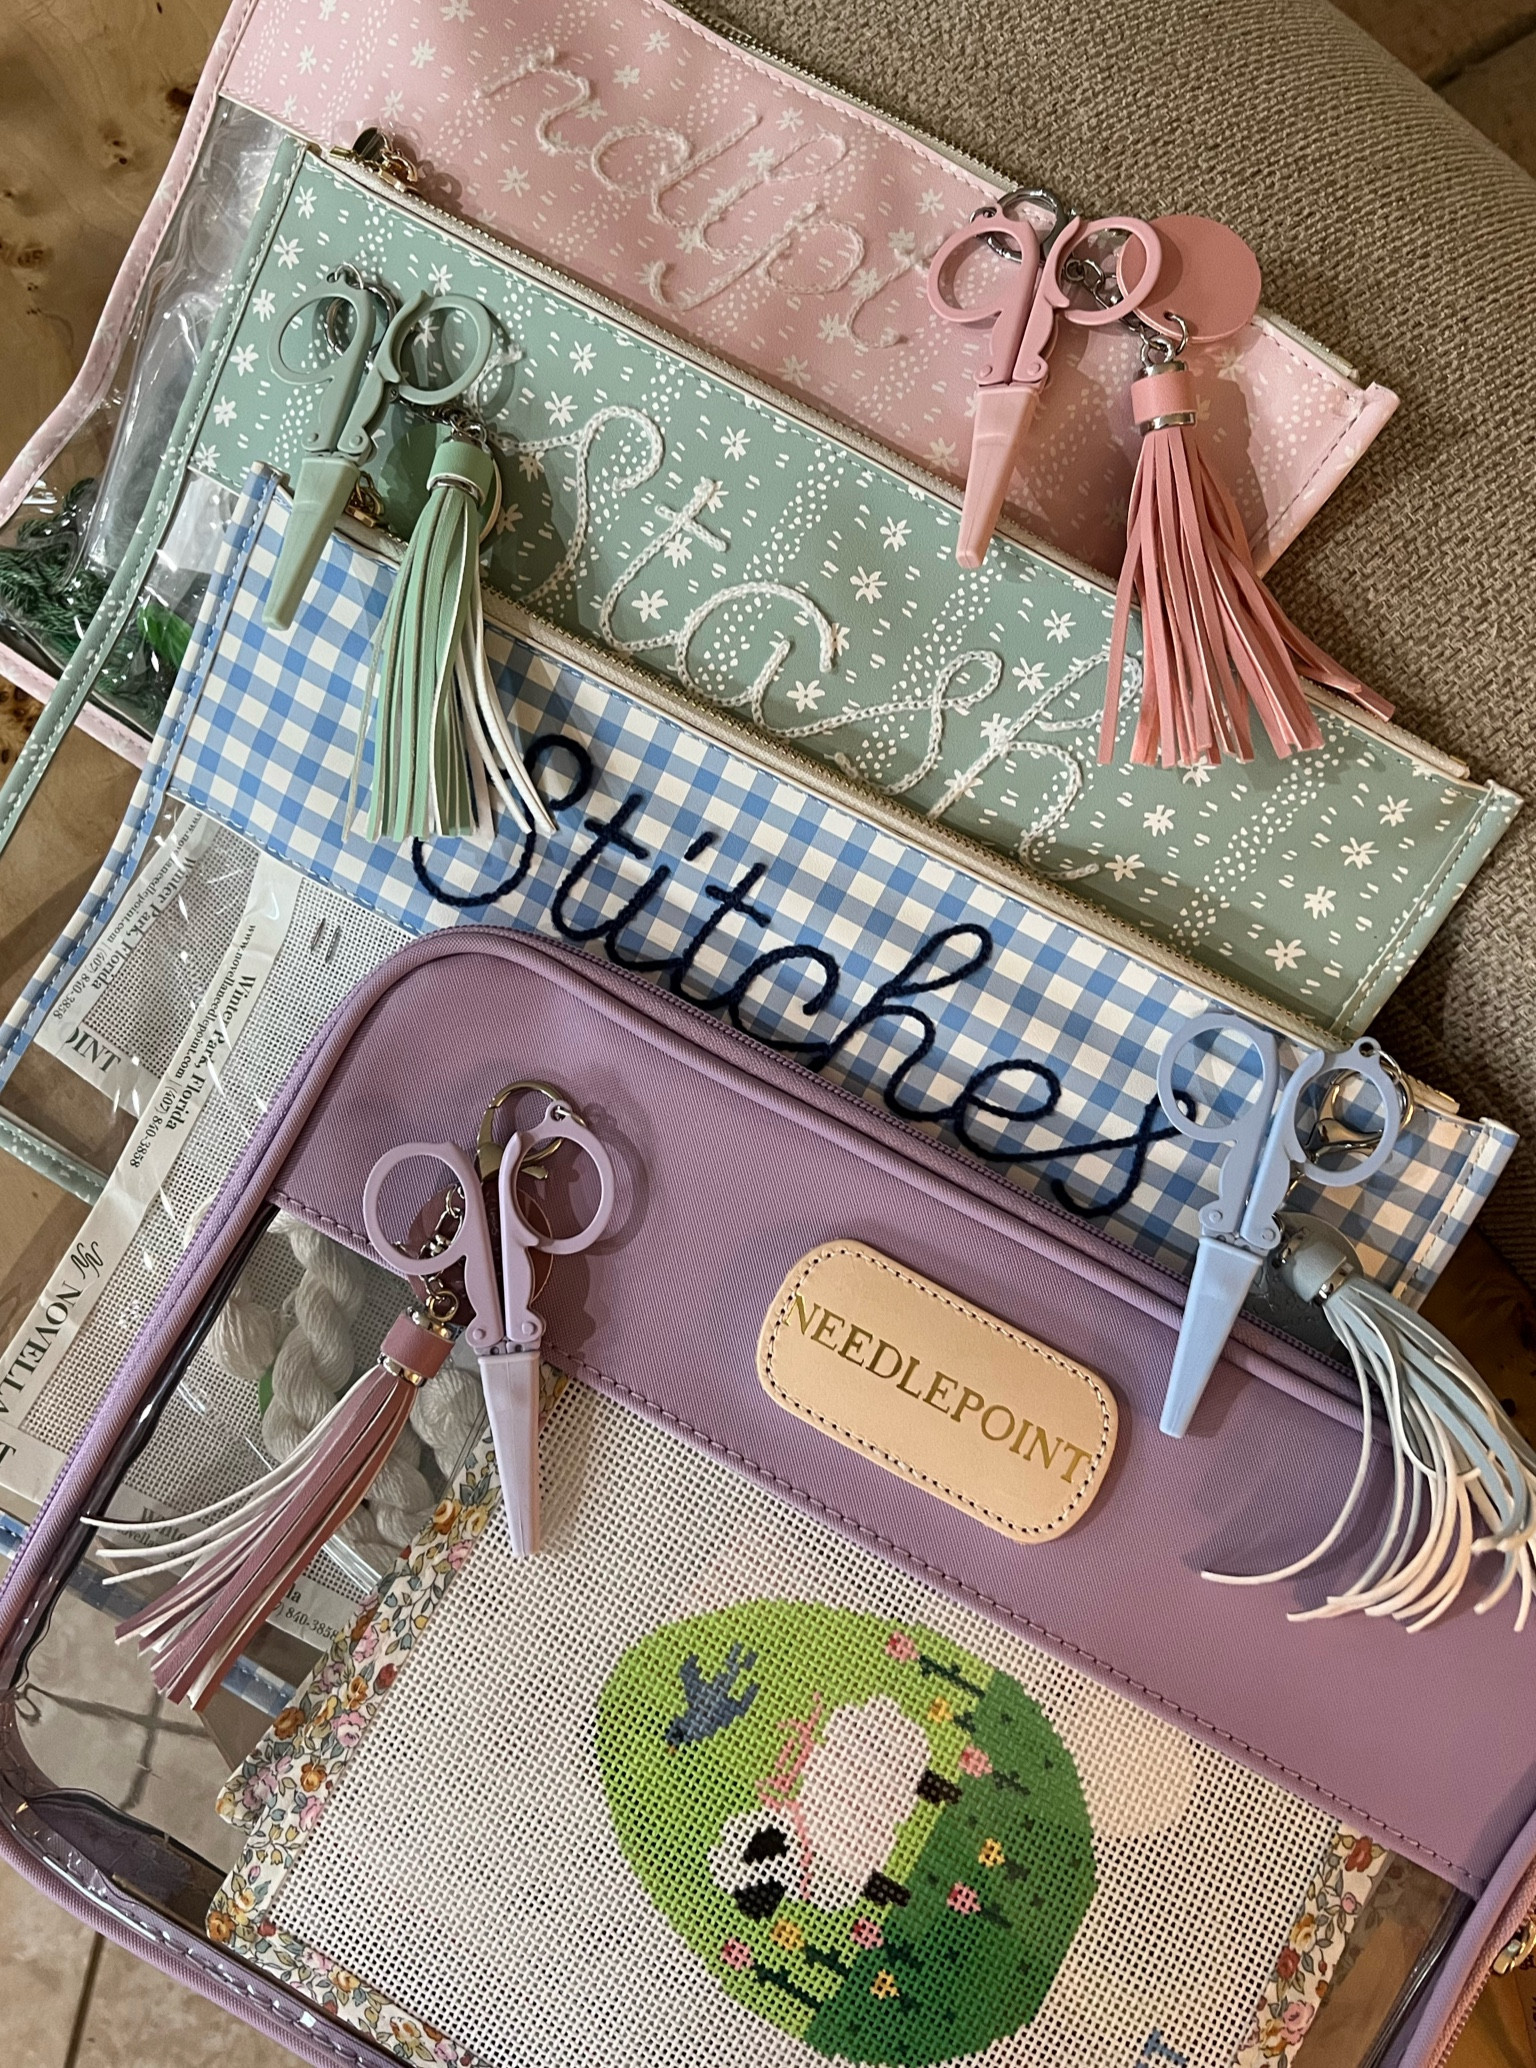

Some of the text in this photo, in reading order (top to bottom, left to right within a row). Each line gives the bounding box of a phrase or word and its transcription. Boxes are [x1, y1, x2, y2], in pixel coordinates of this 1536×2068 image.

[463, 344, 1144, 880] Stash
[155, 857, 197, 899] Winter
[91, 942, 133, 990] Florida
[412, 734, 1196, 1217] Stitches
[53, 974, 92, 1020] 840-3858
[175, 924, 256, 1079] www.novellaneedlepoint.com
[223, 974, 256, 1026] Winter
[166, 1074, 207, 1131] Florida
[129, 1116, 163, 1169] 840-3858
[781, 1291, 1092, 1484] NEEDLEPOINT
[285, 1609, 338, 1641] 840-3858
